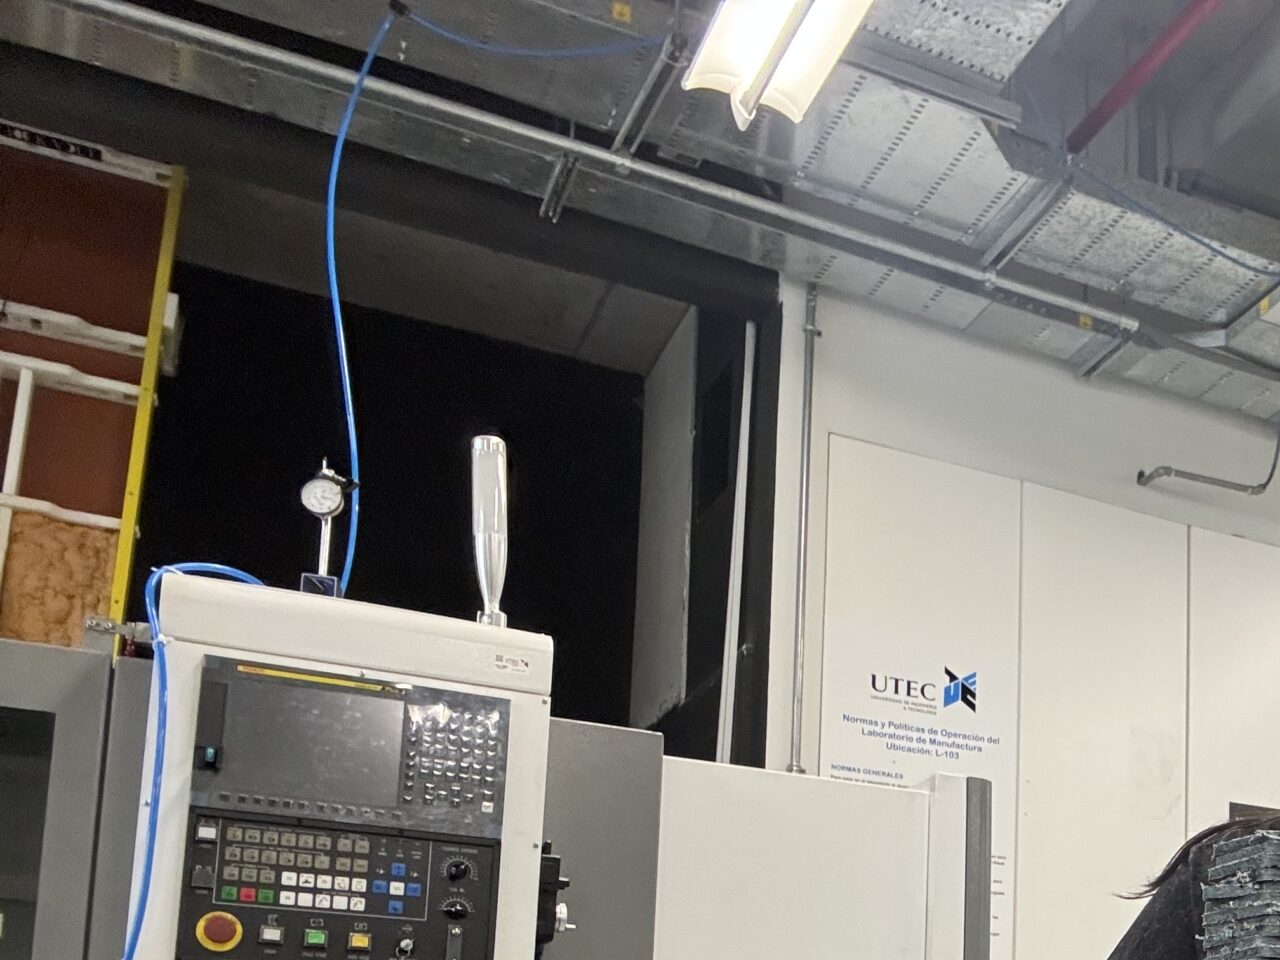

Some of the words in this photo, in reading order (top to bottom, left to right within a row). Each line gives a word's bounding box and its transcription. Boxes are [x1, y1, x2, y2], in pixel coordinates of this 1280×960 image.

[871, 673, 936, 702] UTEC
[842, 713, 879, 727] Normas
[880, 721, 886, 730] y
[927, 727, 939, 736] de
[940, 728, 985, 743] Operación
[986, 736, 1000, 745] del
[861, 727, 914, 743] Laboratorio
[915, 735, 927, 744] de
[929, 737, 983, 753] Manufactura
[886, 741, 933, 757] Ubicación:
[935, 749, 960, 760] L-103
[830, 763, 861, 775] NORMAS
[862, 768, 904, 780] GENERALES
